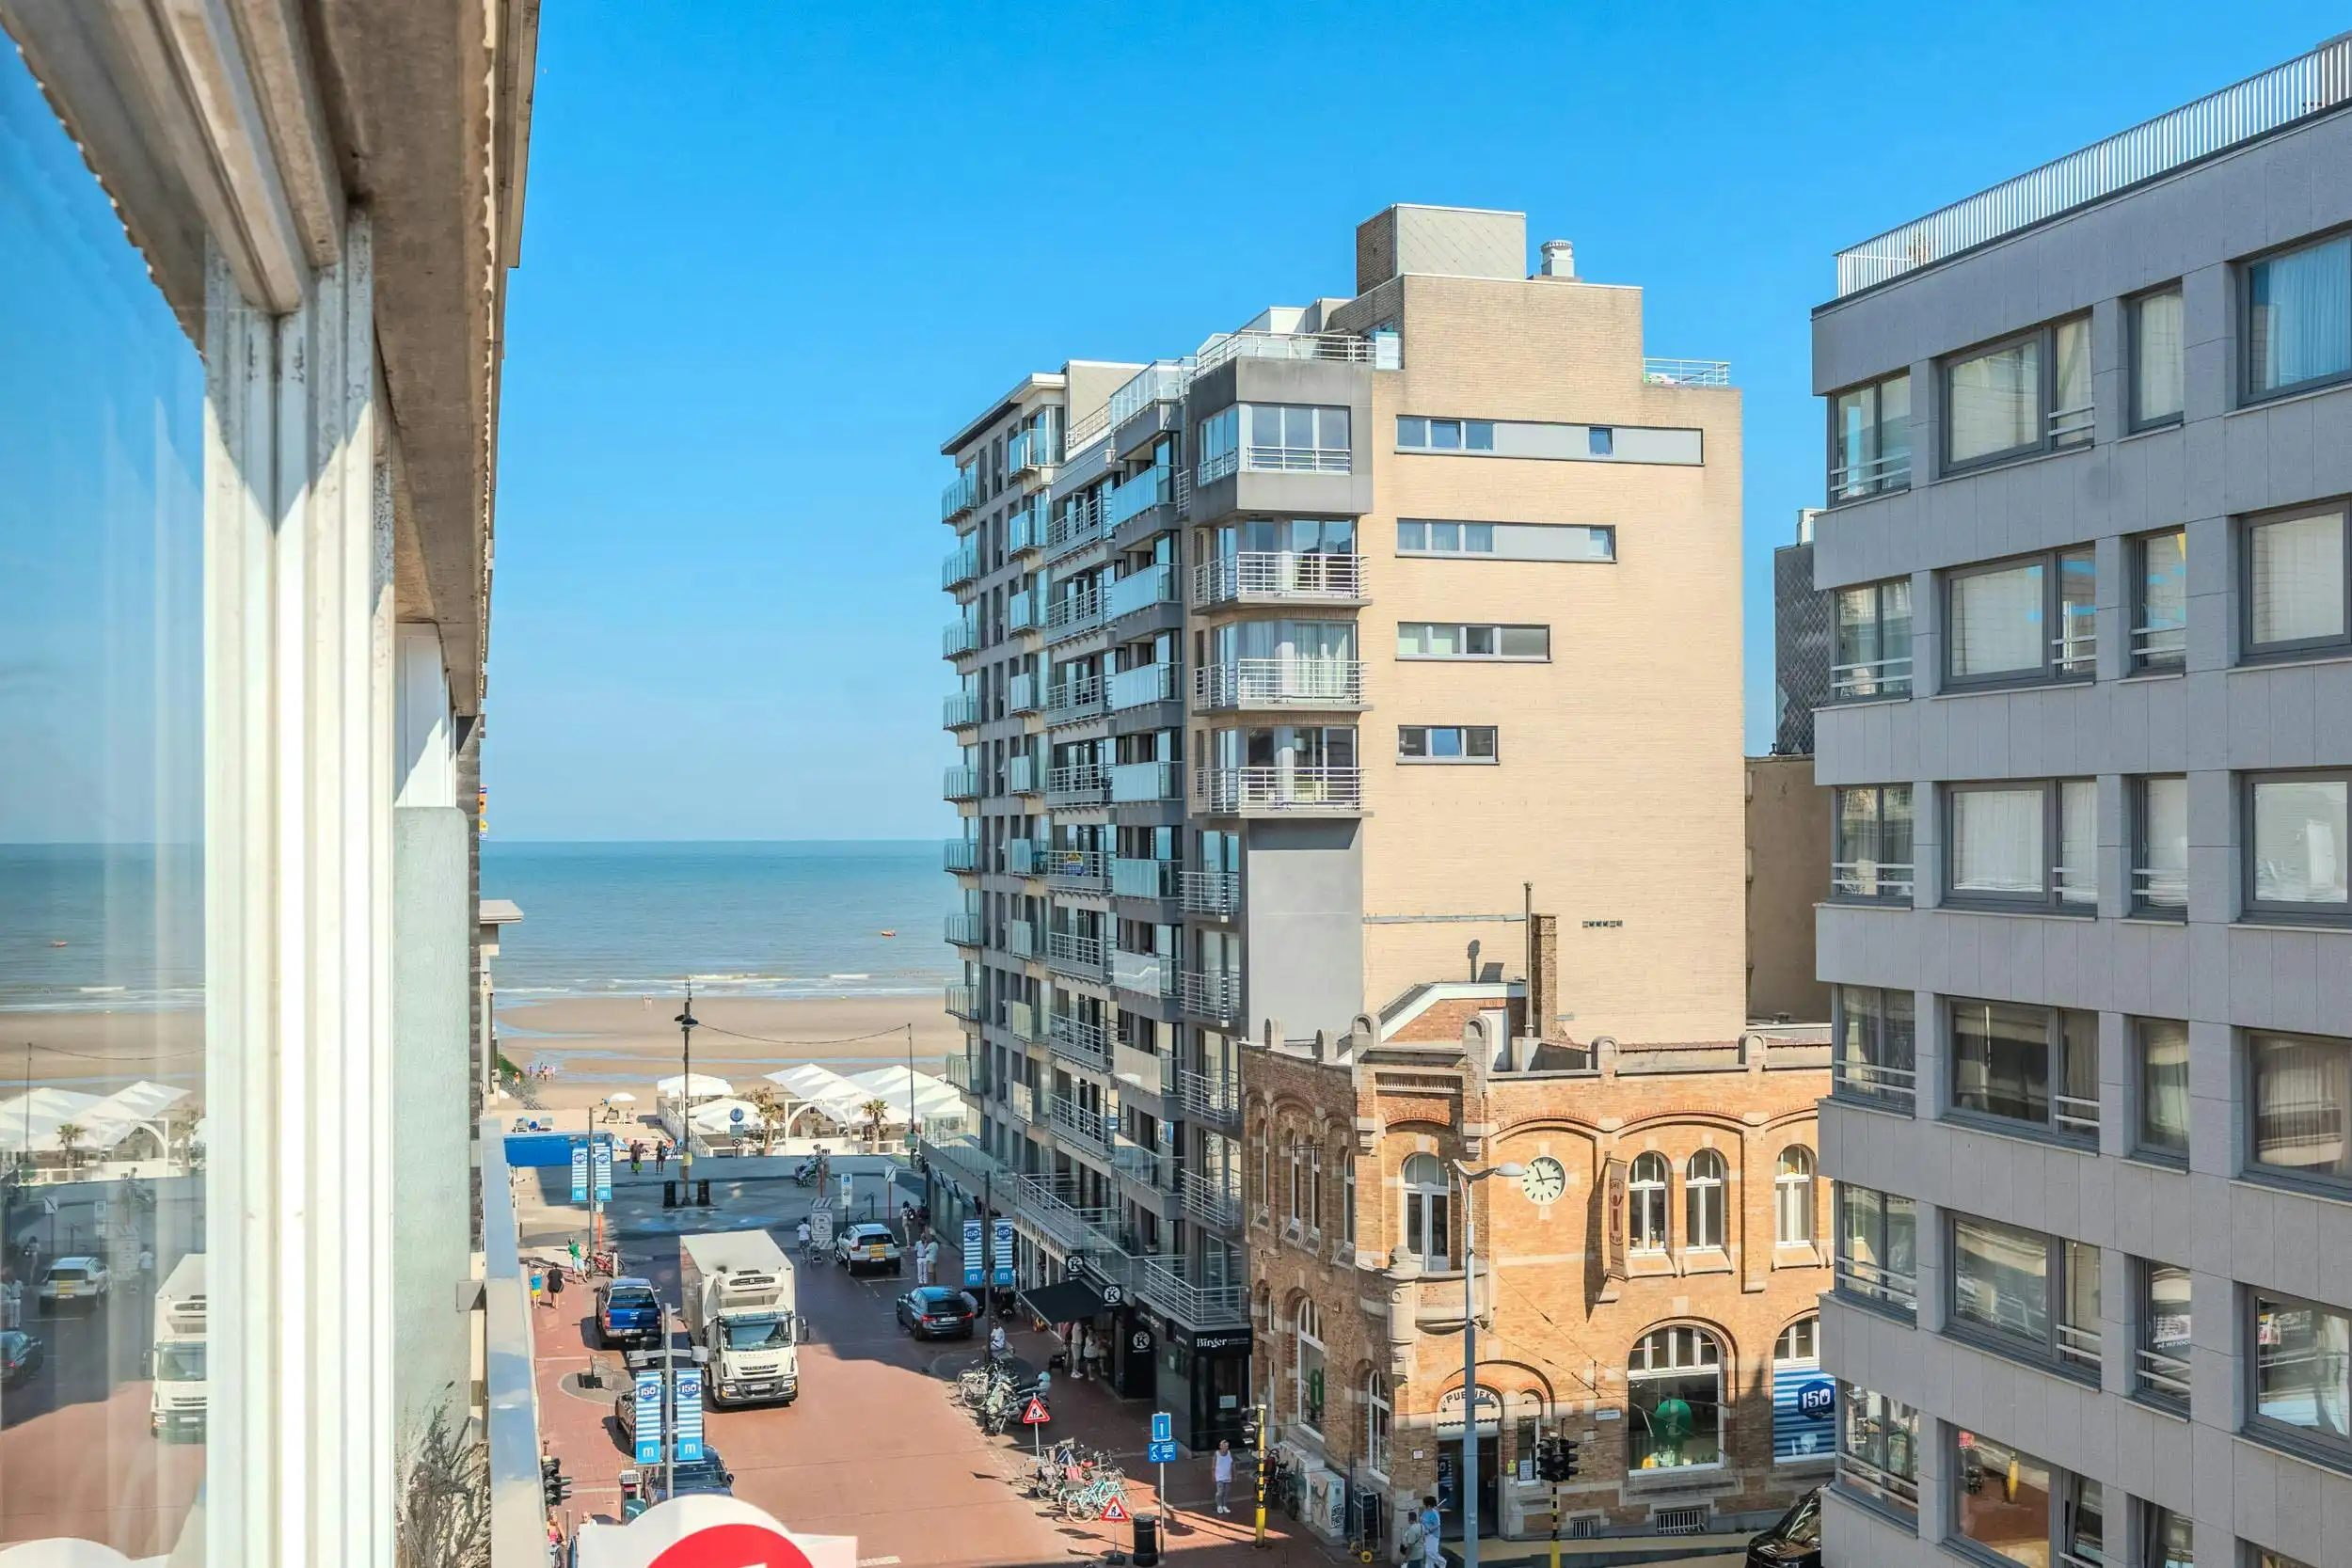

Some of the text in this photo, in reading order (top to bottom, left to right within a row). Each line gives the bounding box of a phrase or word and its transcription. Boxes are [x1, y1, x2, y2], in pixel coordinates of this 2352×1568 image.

[998, 1228, 1009, 1237] 150
[999, 1272, 1009, 1280] m
[640, 1386, 658, 1397] 150
[681, 1383, 698, 1394] 150
[1802, 1387, 1832, 1409] 150
[642, 1446, 655, 1459] m
[684, 1442, 697, 1455] m
